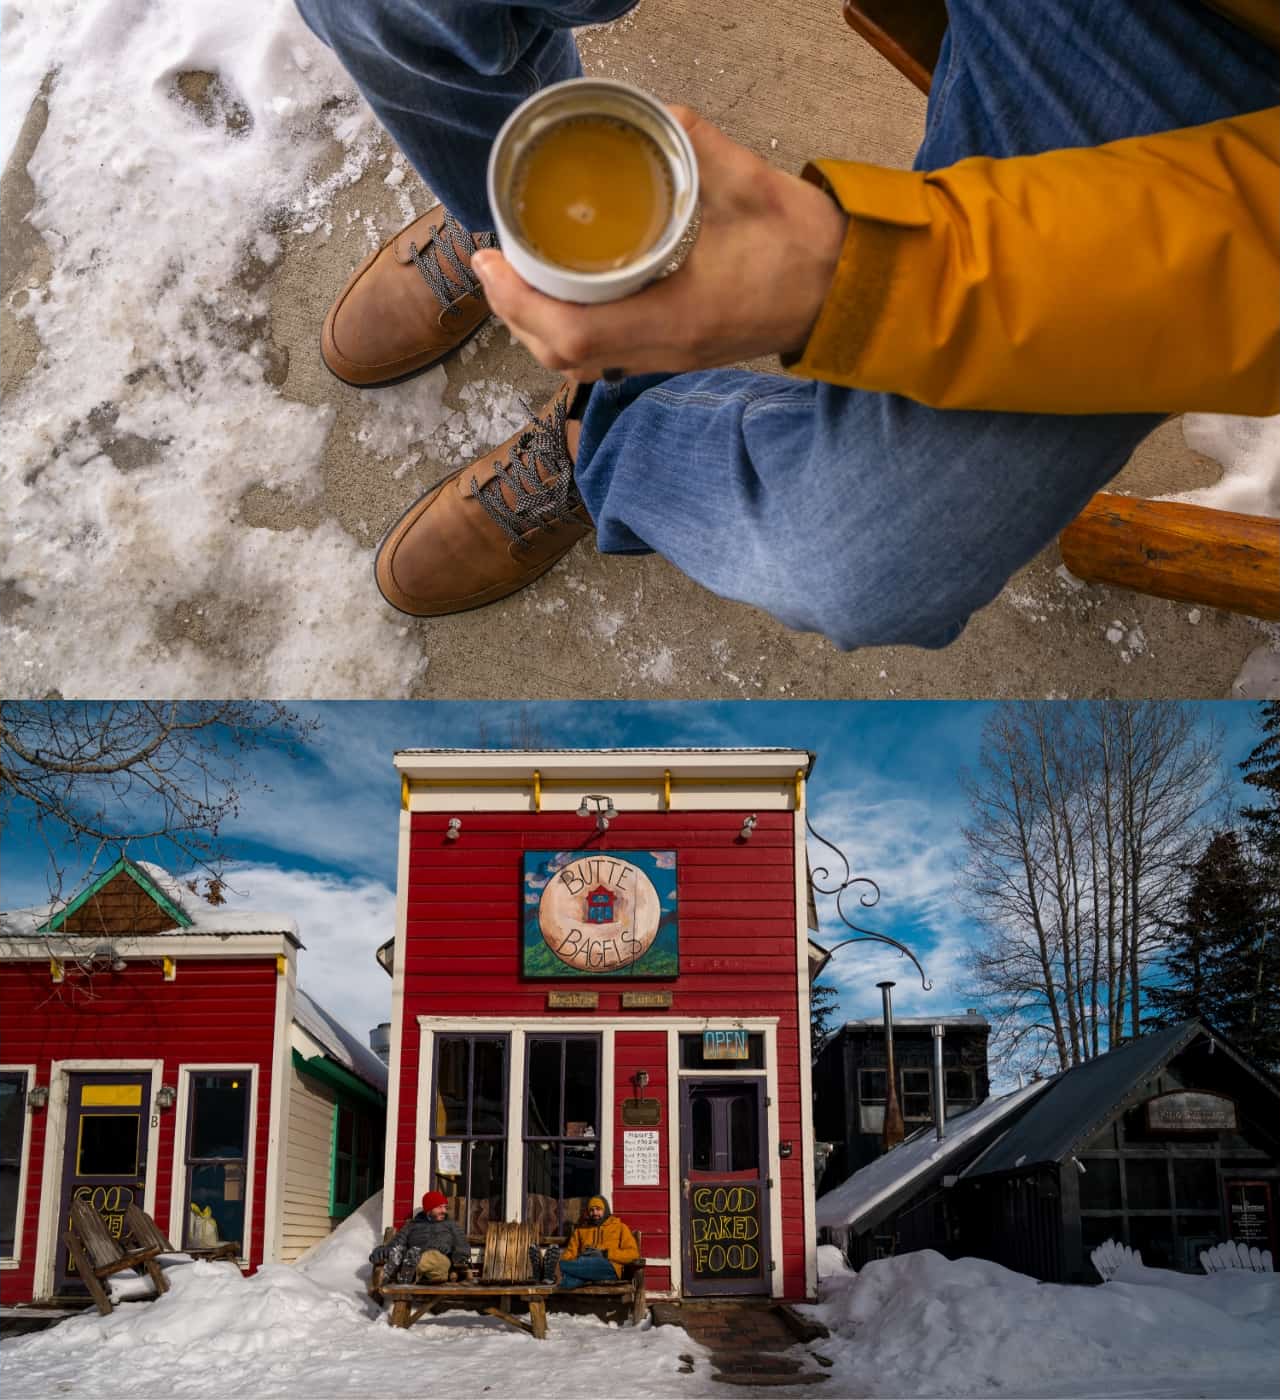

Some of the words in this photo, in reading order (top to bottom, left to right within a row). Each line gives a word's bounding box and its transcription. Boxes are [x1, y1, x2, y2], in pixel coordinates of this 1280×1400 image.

[560, 859, 633, 895] BUTTE
[556, 928, 643, 968] BAGELS
[704, 1031, 746, 1057] OPEN
[151, 1115, 158, 1128] B
[694, 1188, 756, 1213] GOOD
[692, 1216, 759, 1243] BAKED
[694, 1244, 759, 1272] FOOD
